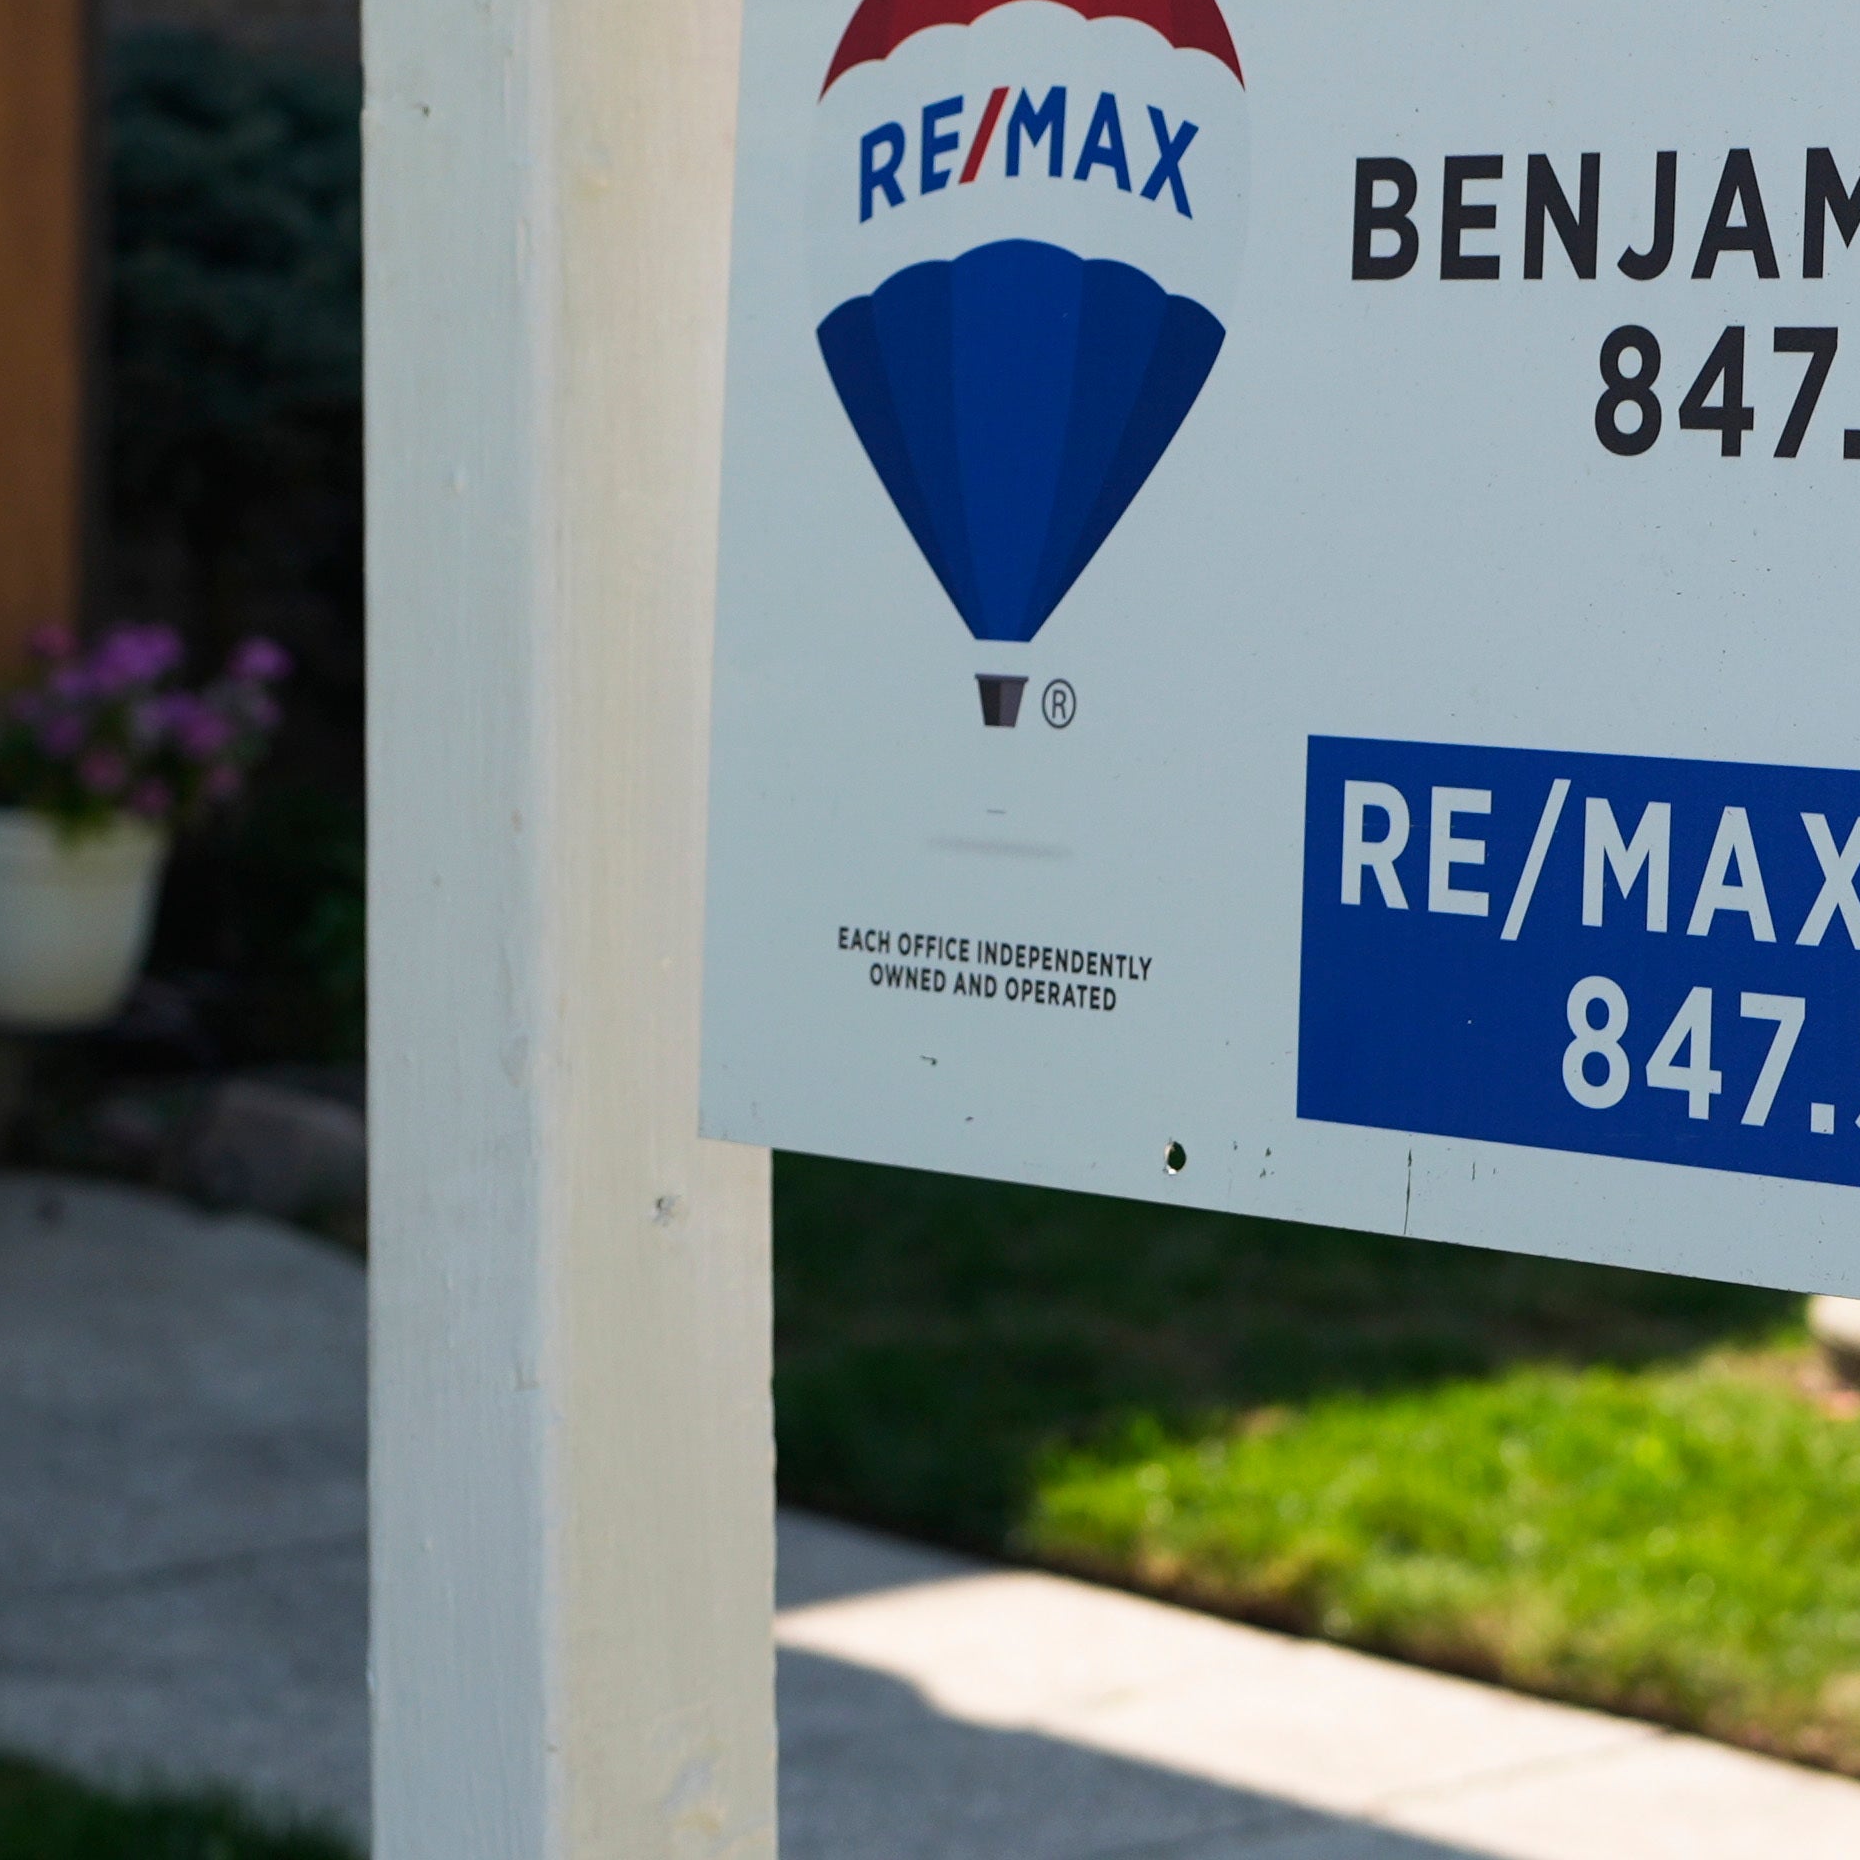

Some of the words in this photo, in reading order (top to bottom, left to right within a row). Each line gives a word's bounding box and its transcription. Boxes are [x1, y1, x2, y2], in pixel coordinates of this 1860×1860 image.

[859, 85, 1199, 223] RE/MAX
[838, 926, 890, 954] EACH
[897, 932, 970, 963] OFFICE
[977, 941, 1152, 982] INDEPENDENTLY
[869, 962, 946, 993] OWNED
[953, 972, 997, 998] AND
[1005, 979, 1117, 1012] OPERATED
